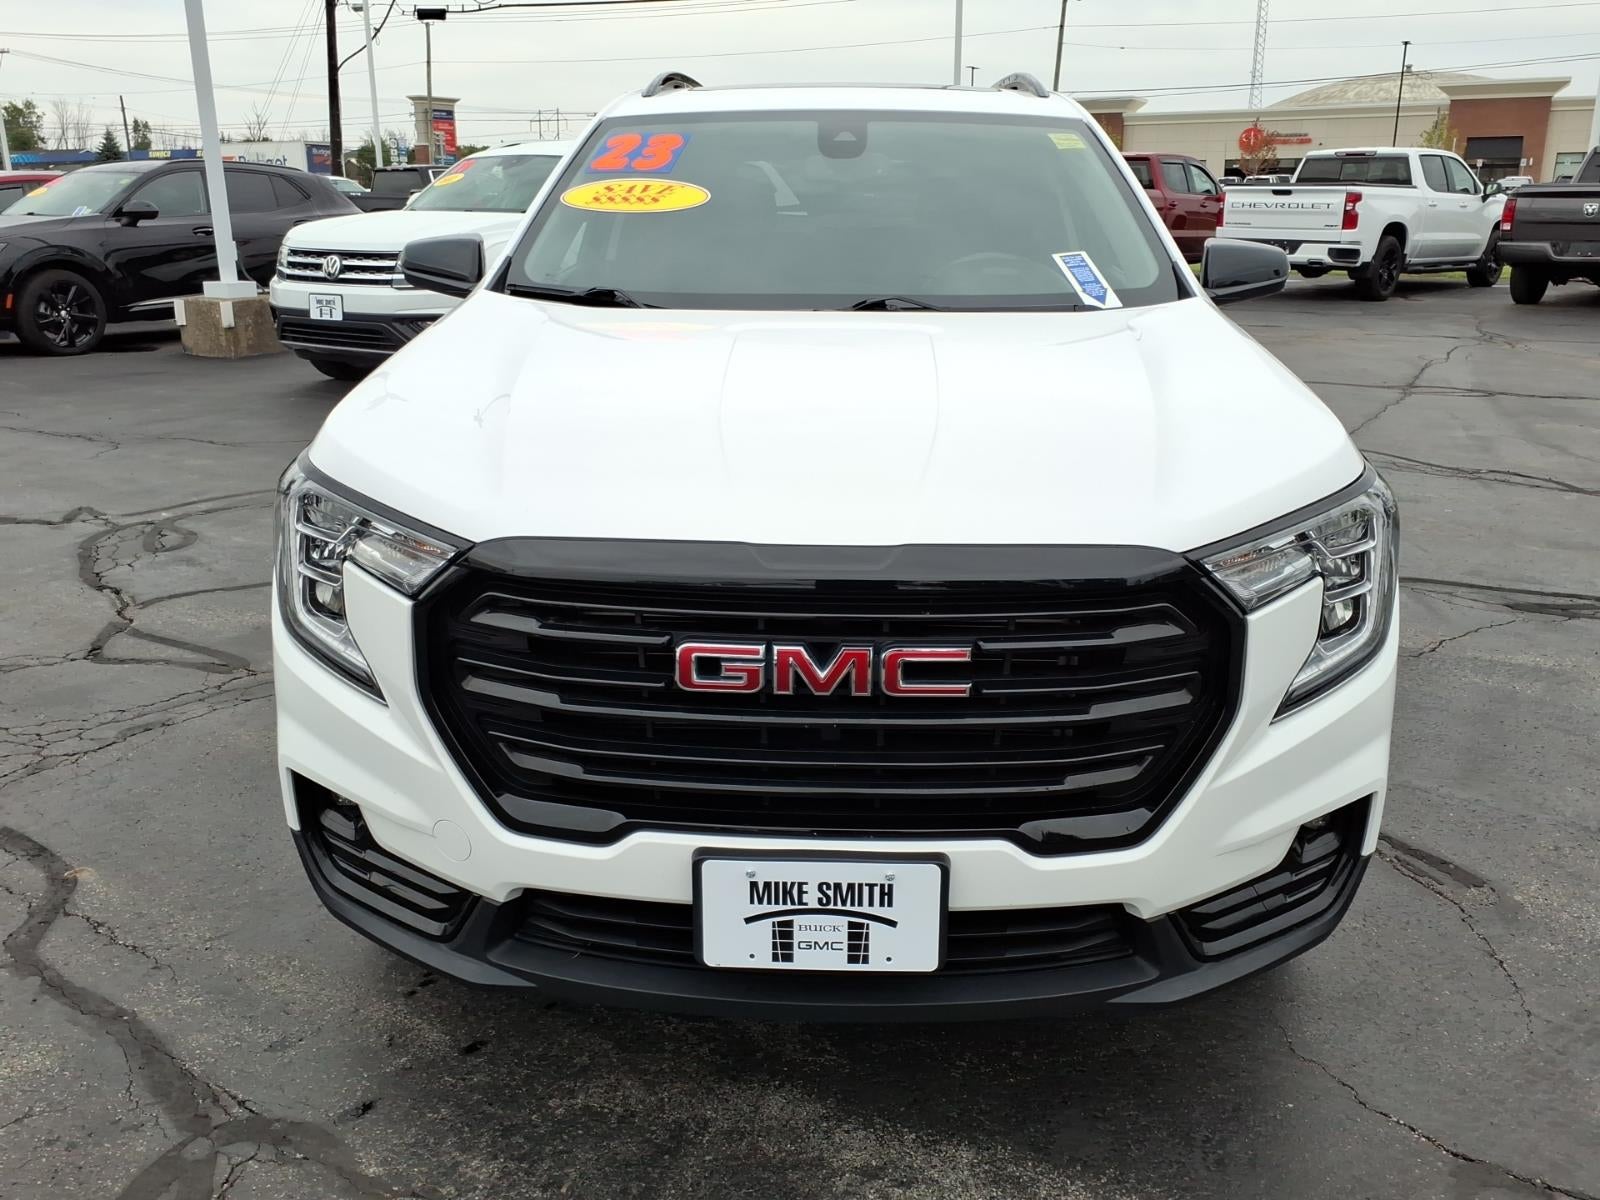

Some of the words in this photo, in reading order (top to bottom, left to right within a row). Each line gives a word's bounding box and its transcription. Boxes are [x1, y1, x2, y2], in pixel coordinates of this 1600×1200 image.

[590, 133, 684, 171] 23
[1231, 201, 1334, 209] CHEVROLET
[674, 642, 973, 697] GMC
[749, 880, 809, 907] MIKE
[816, 881, 894, 908] SMITH
[797, 923, 844, 933] BUICK
[797, 940, 844, 951] GMC
